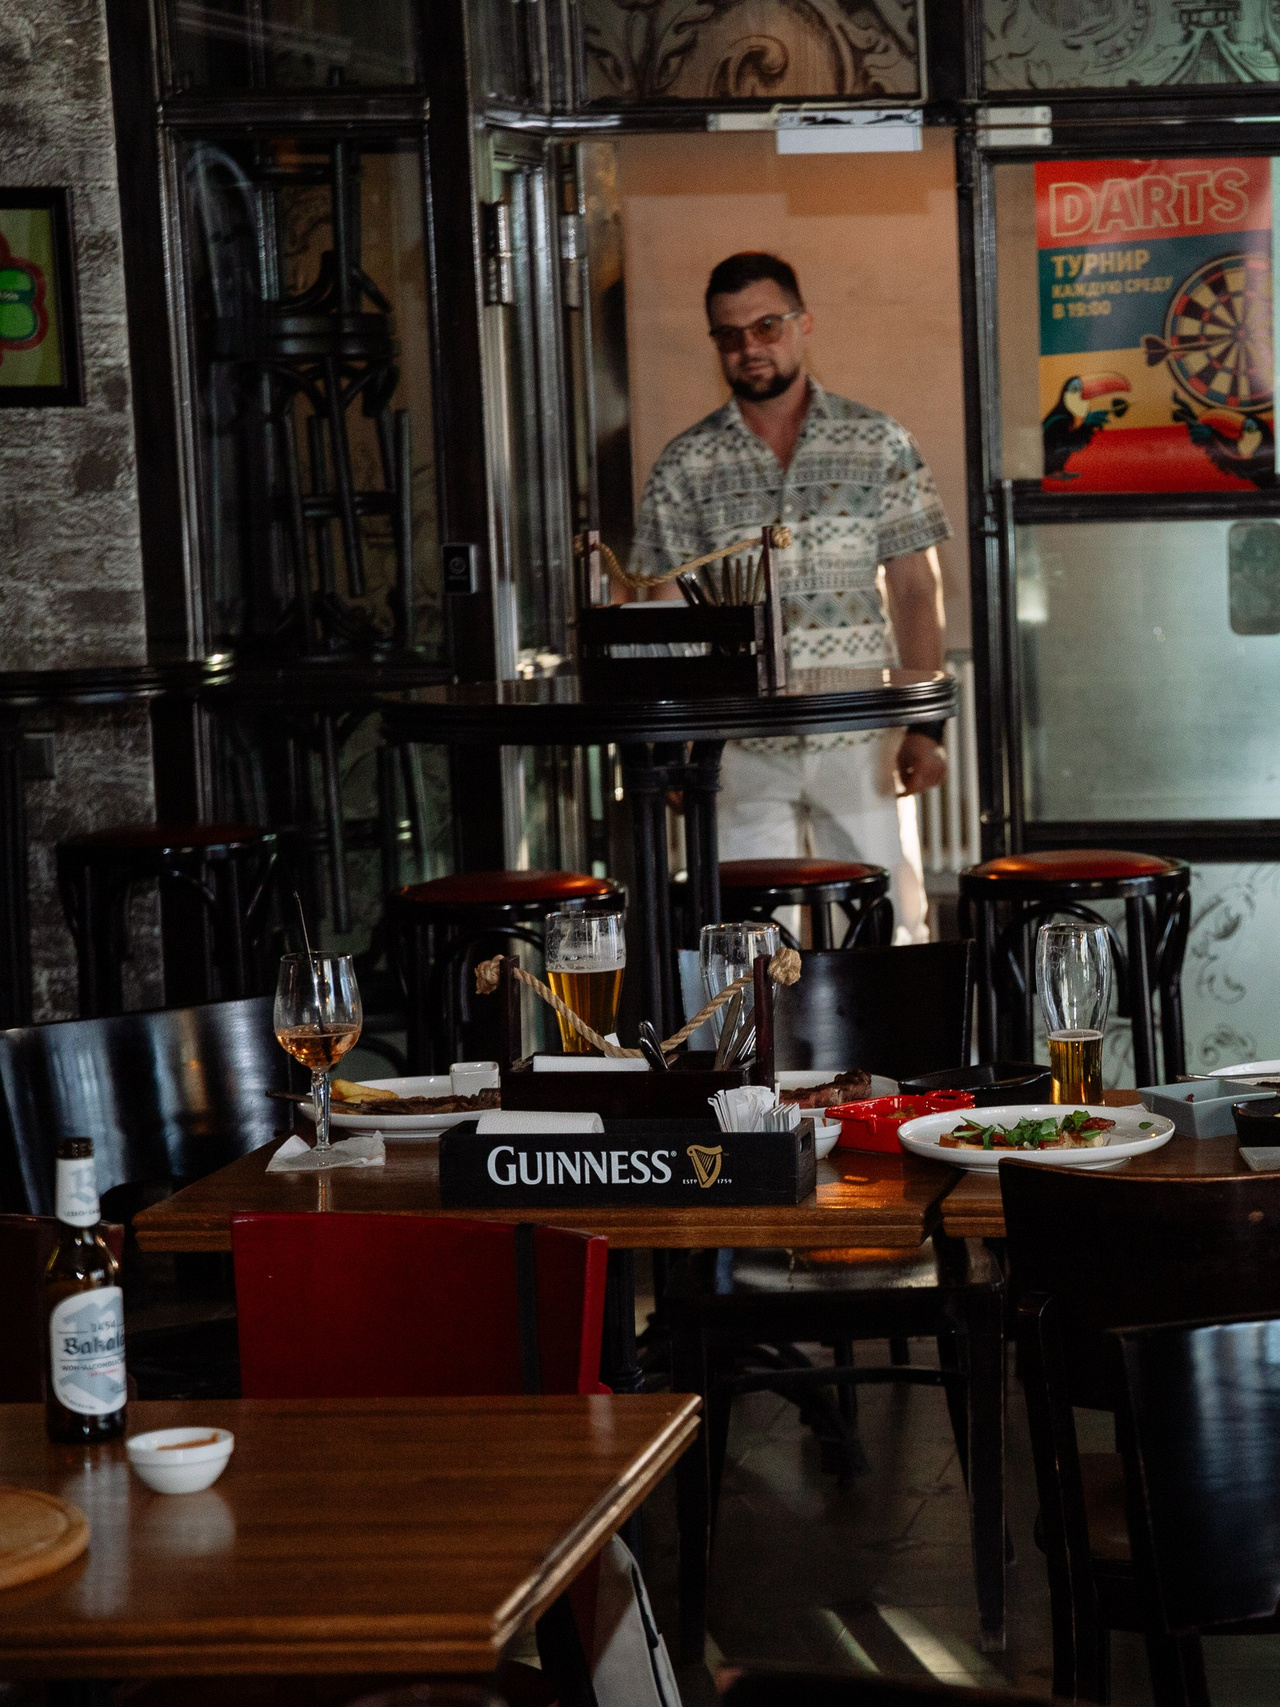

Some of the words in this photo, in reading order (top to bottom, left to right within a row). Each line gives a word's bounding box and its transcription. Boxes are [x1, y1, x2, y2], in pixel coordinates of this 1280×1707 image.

[1049, 167, 1251, 238] DARTS
[1051, 249, 1150, 278] ТУРНИР
[1052, 281, 1122, 298] КАЖДУЮ
[1124, 276, 1173, 293] СРЕДУ
[1052, 303, 1065, 319] В
[1068, 300, 1112, 318] 19:00
[487, 1146, 672, 1185] GUINNESS
